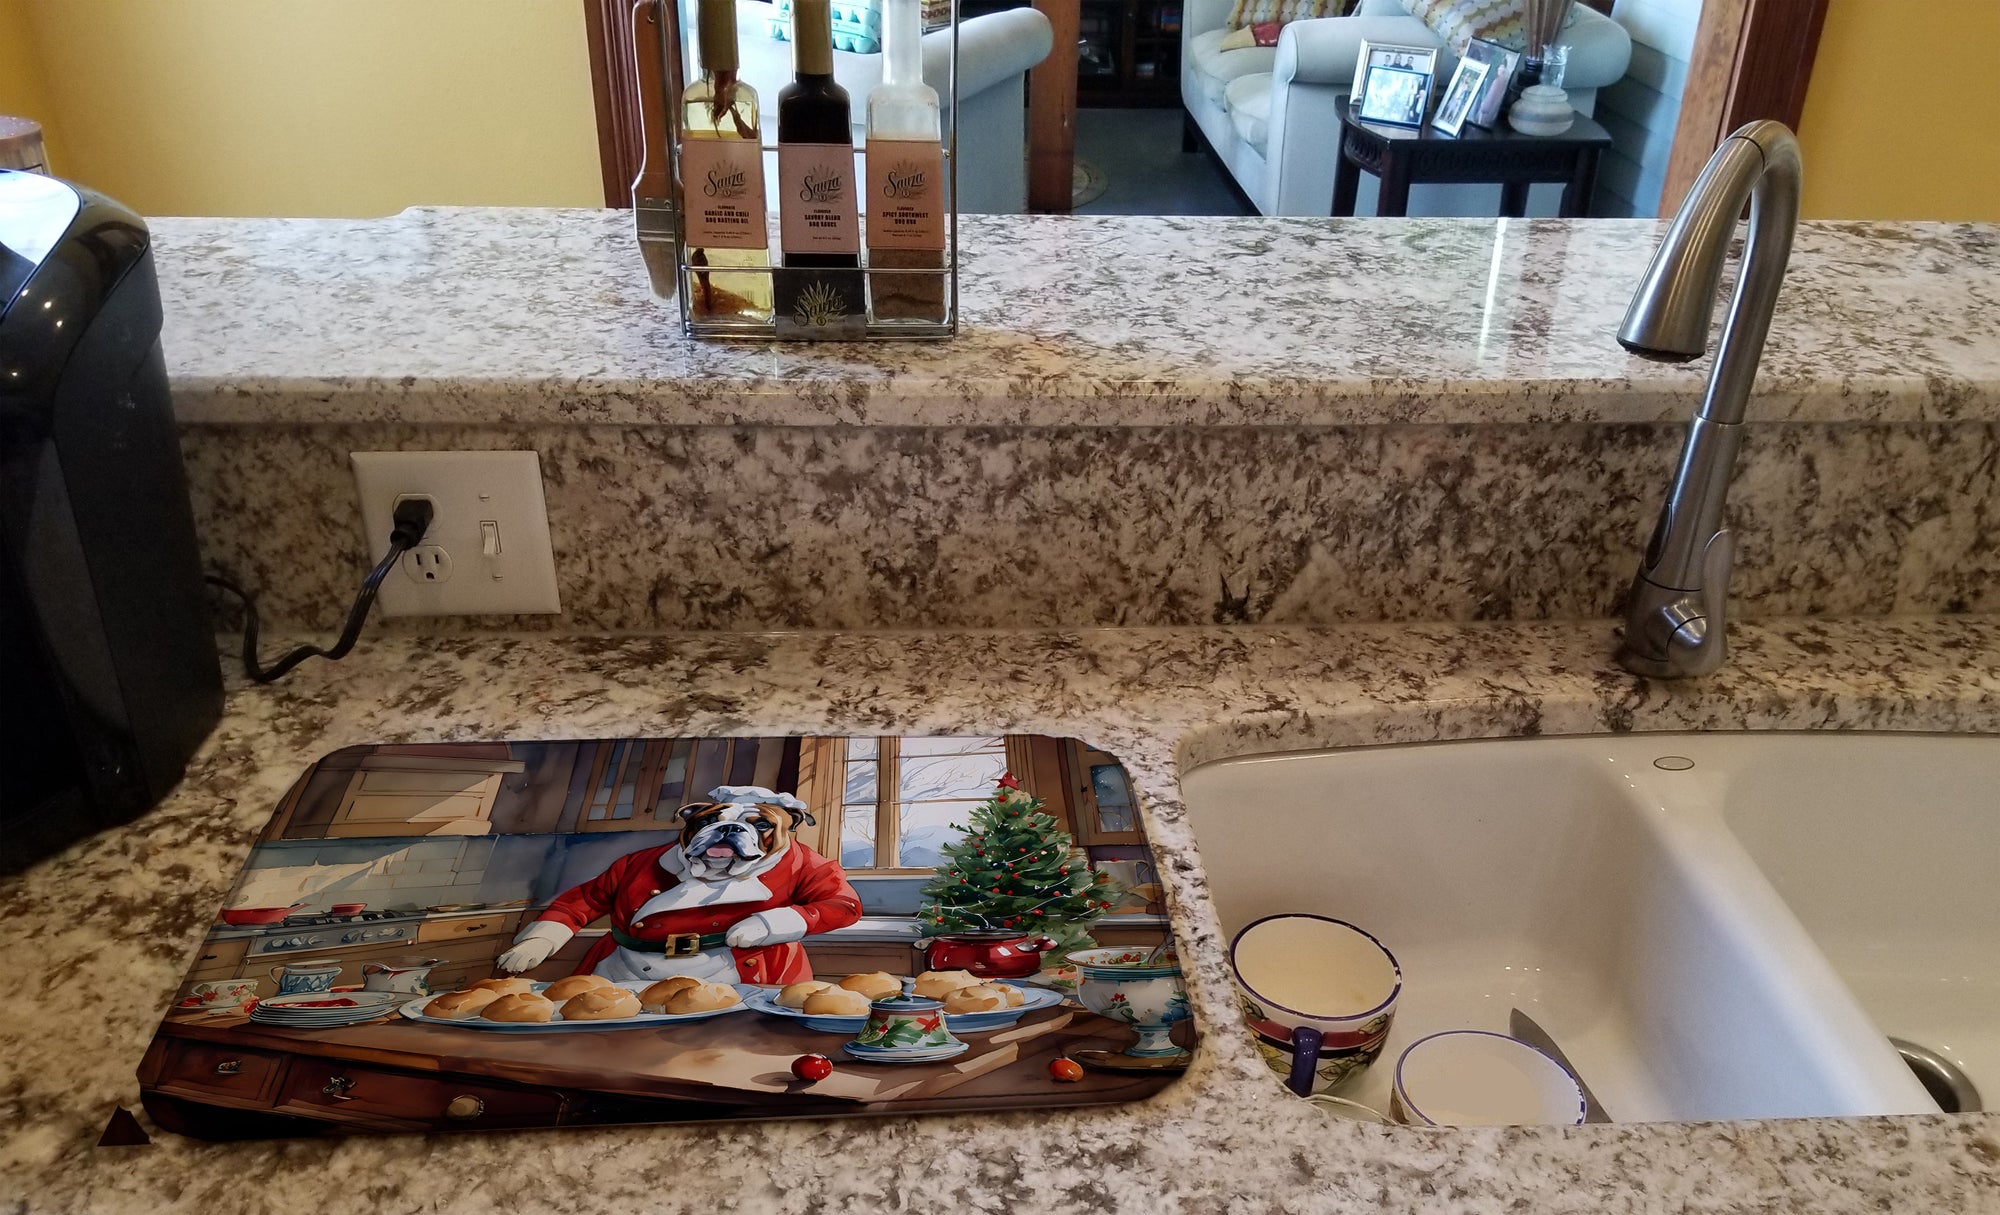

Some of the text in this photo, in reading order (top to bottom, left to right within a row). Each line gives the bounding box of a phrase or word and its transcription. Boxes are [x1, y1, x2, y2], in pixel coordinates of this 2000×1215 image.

[703, 170, 746, 197] Sauza
[800, 175, 841, 202] Sauza
[883, 171, 926, 198] Sauza
